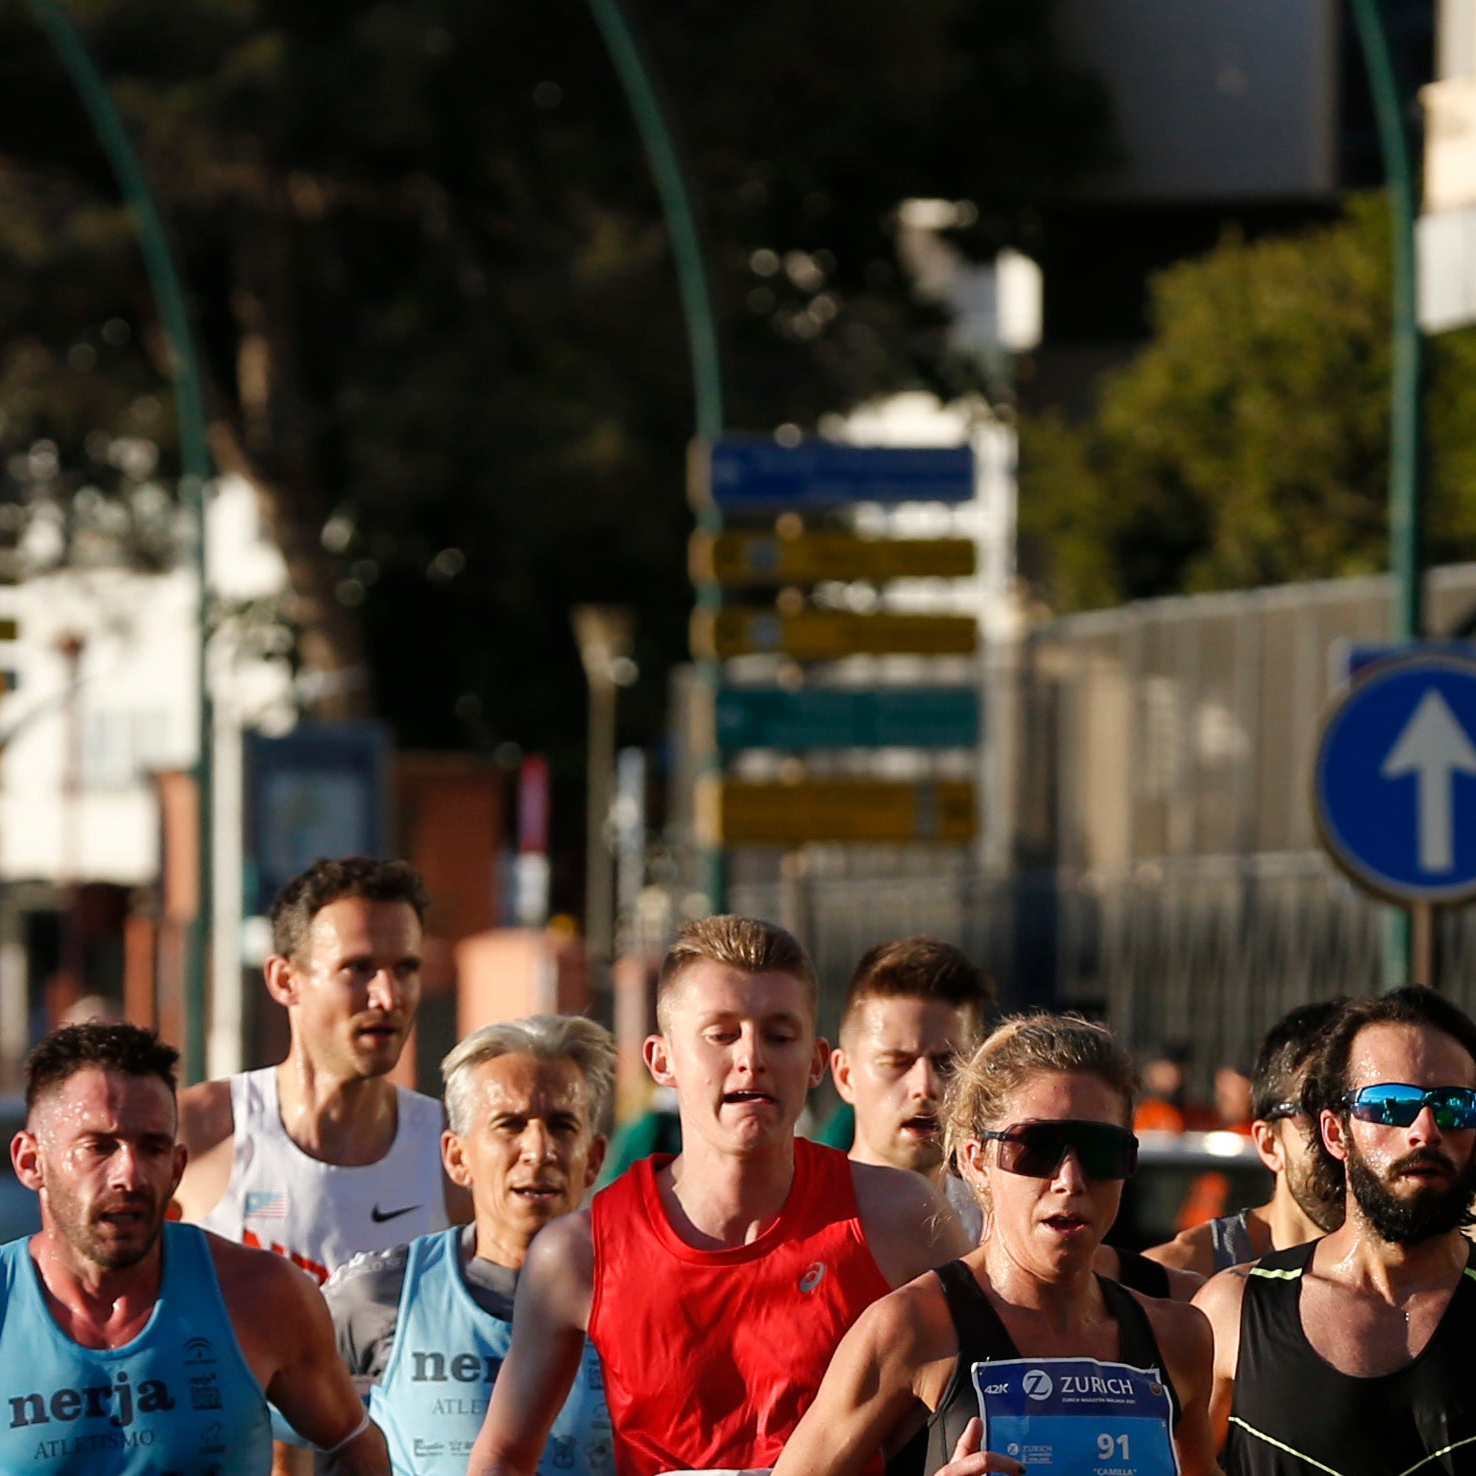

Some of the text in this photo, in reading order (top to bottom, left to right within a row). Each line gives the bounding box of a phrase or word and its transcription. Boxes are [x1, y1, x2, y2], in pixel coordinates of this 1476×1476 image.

[411, 1350, 505, 1384] ner
[9, 1371, 176, 1428] nerja
[984, 1382, 1009, 1394] 42K
[1060, 1376, 1134, 1395] ZURICH
[34, 1429, 155, 1459] ATLETISMO
[1096, 1433, 1130, 1460] 91
